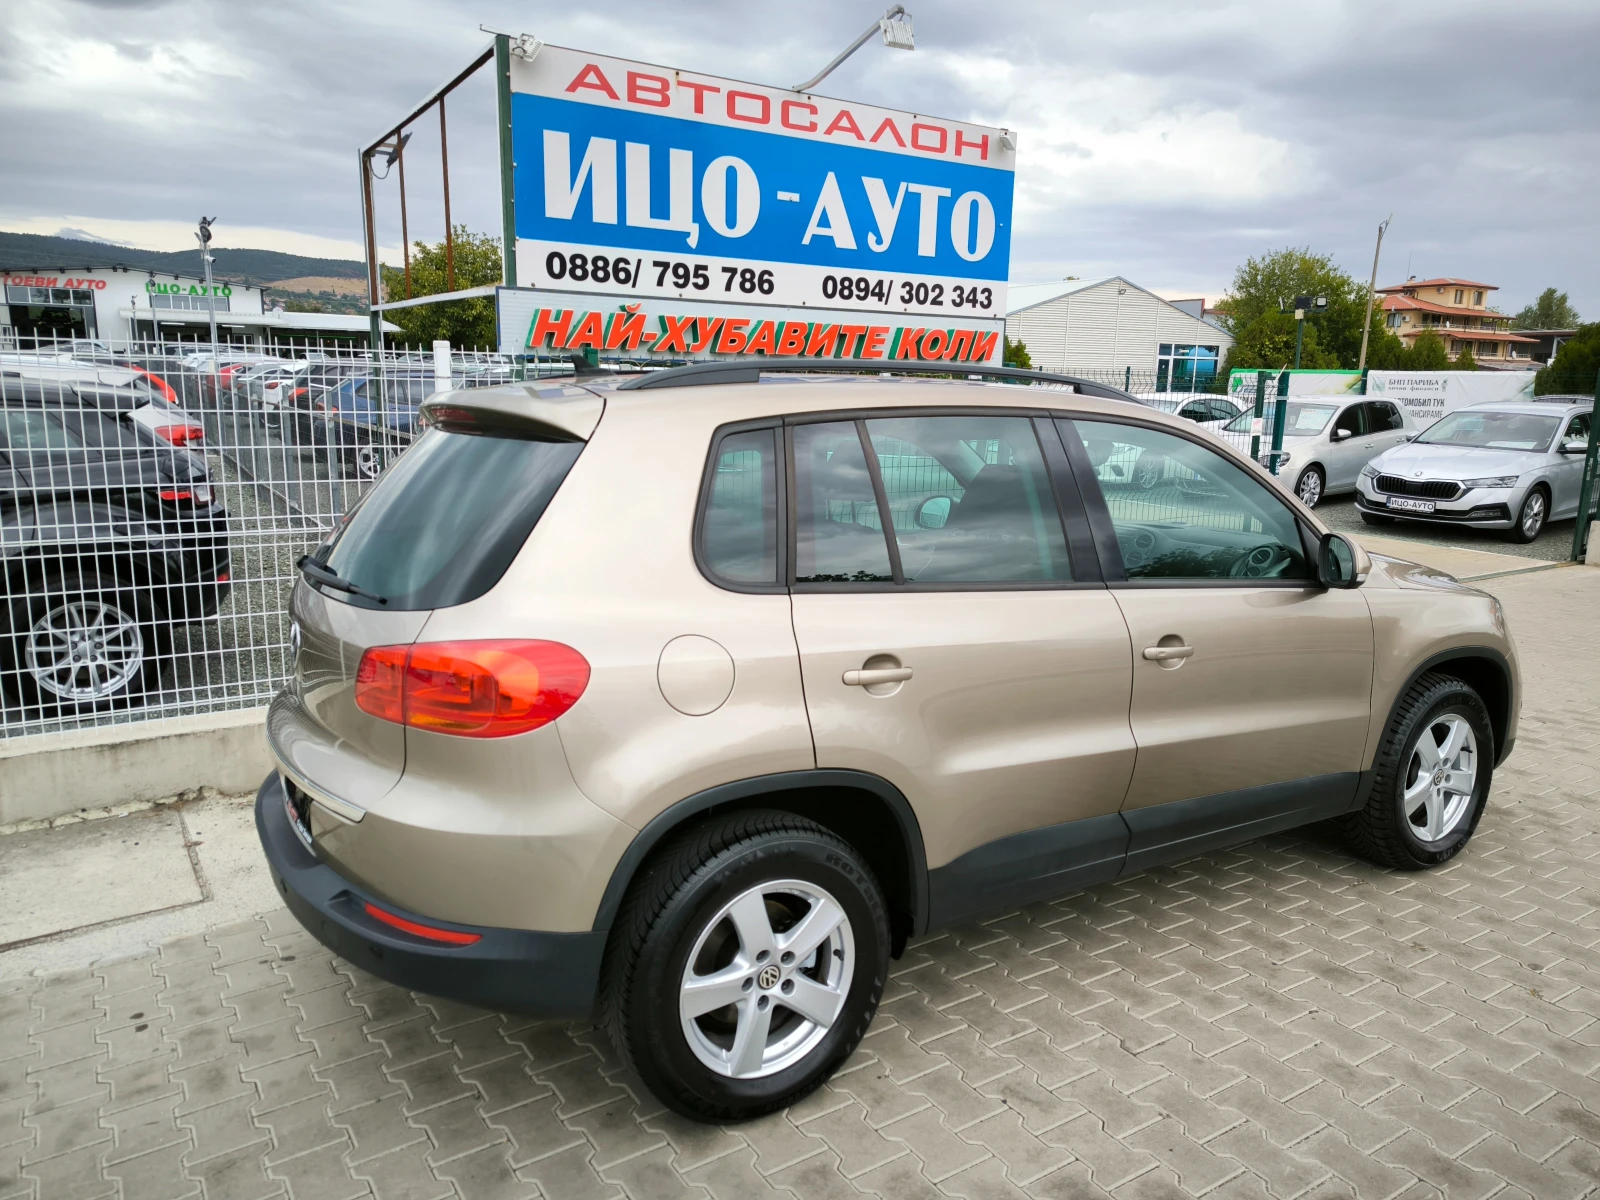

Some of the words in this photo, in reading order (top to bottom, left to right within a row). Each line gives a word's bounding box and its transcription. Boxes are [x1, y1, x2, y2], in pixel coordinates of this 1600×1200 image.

[565, 63, 990, 161] АВТОСАЛОН
[63, 278, 107, 290] АУТО
[545, 252, 642, 289] 0886/
[652, 260, 710, 291] 795
[721, 267, 775, 295] 786
[822, 275, 894, 305] 0894/
[900, 281, 944, 306] 302
[951, 285, 993, 310] 343
[529, 305, 890, 358] НАЙ-ХУБАВИТЕ
[896, 327, 999, 362] КОЛИ
[1388, 378, 1405, 386] БНП
[1394, 397, 1431, 407] ТОМОБИЛ
[1432, 398, 1446, 407] ТУК
[1391, 499, 1434, 510] ИЦО-АУТО
